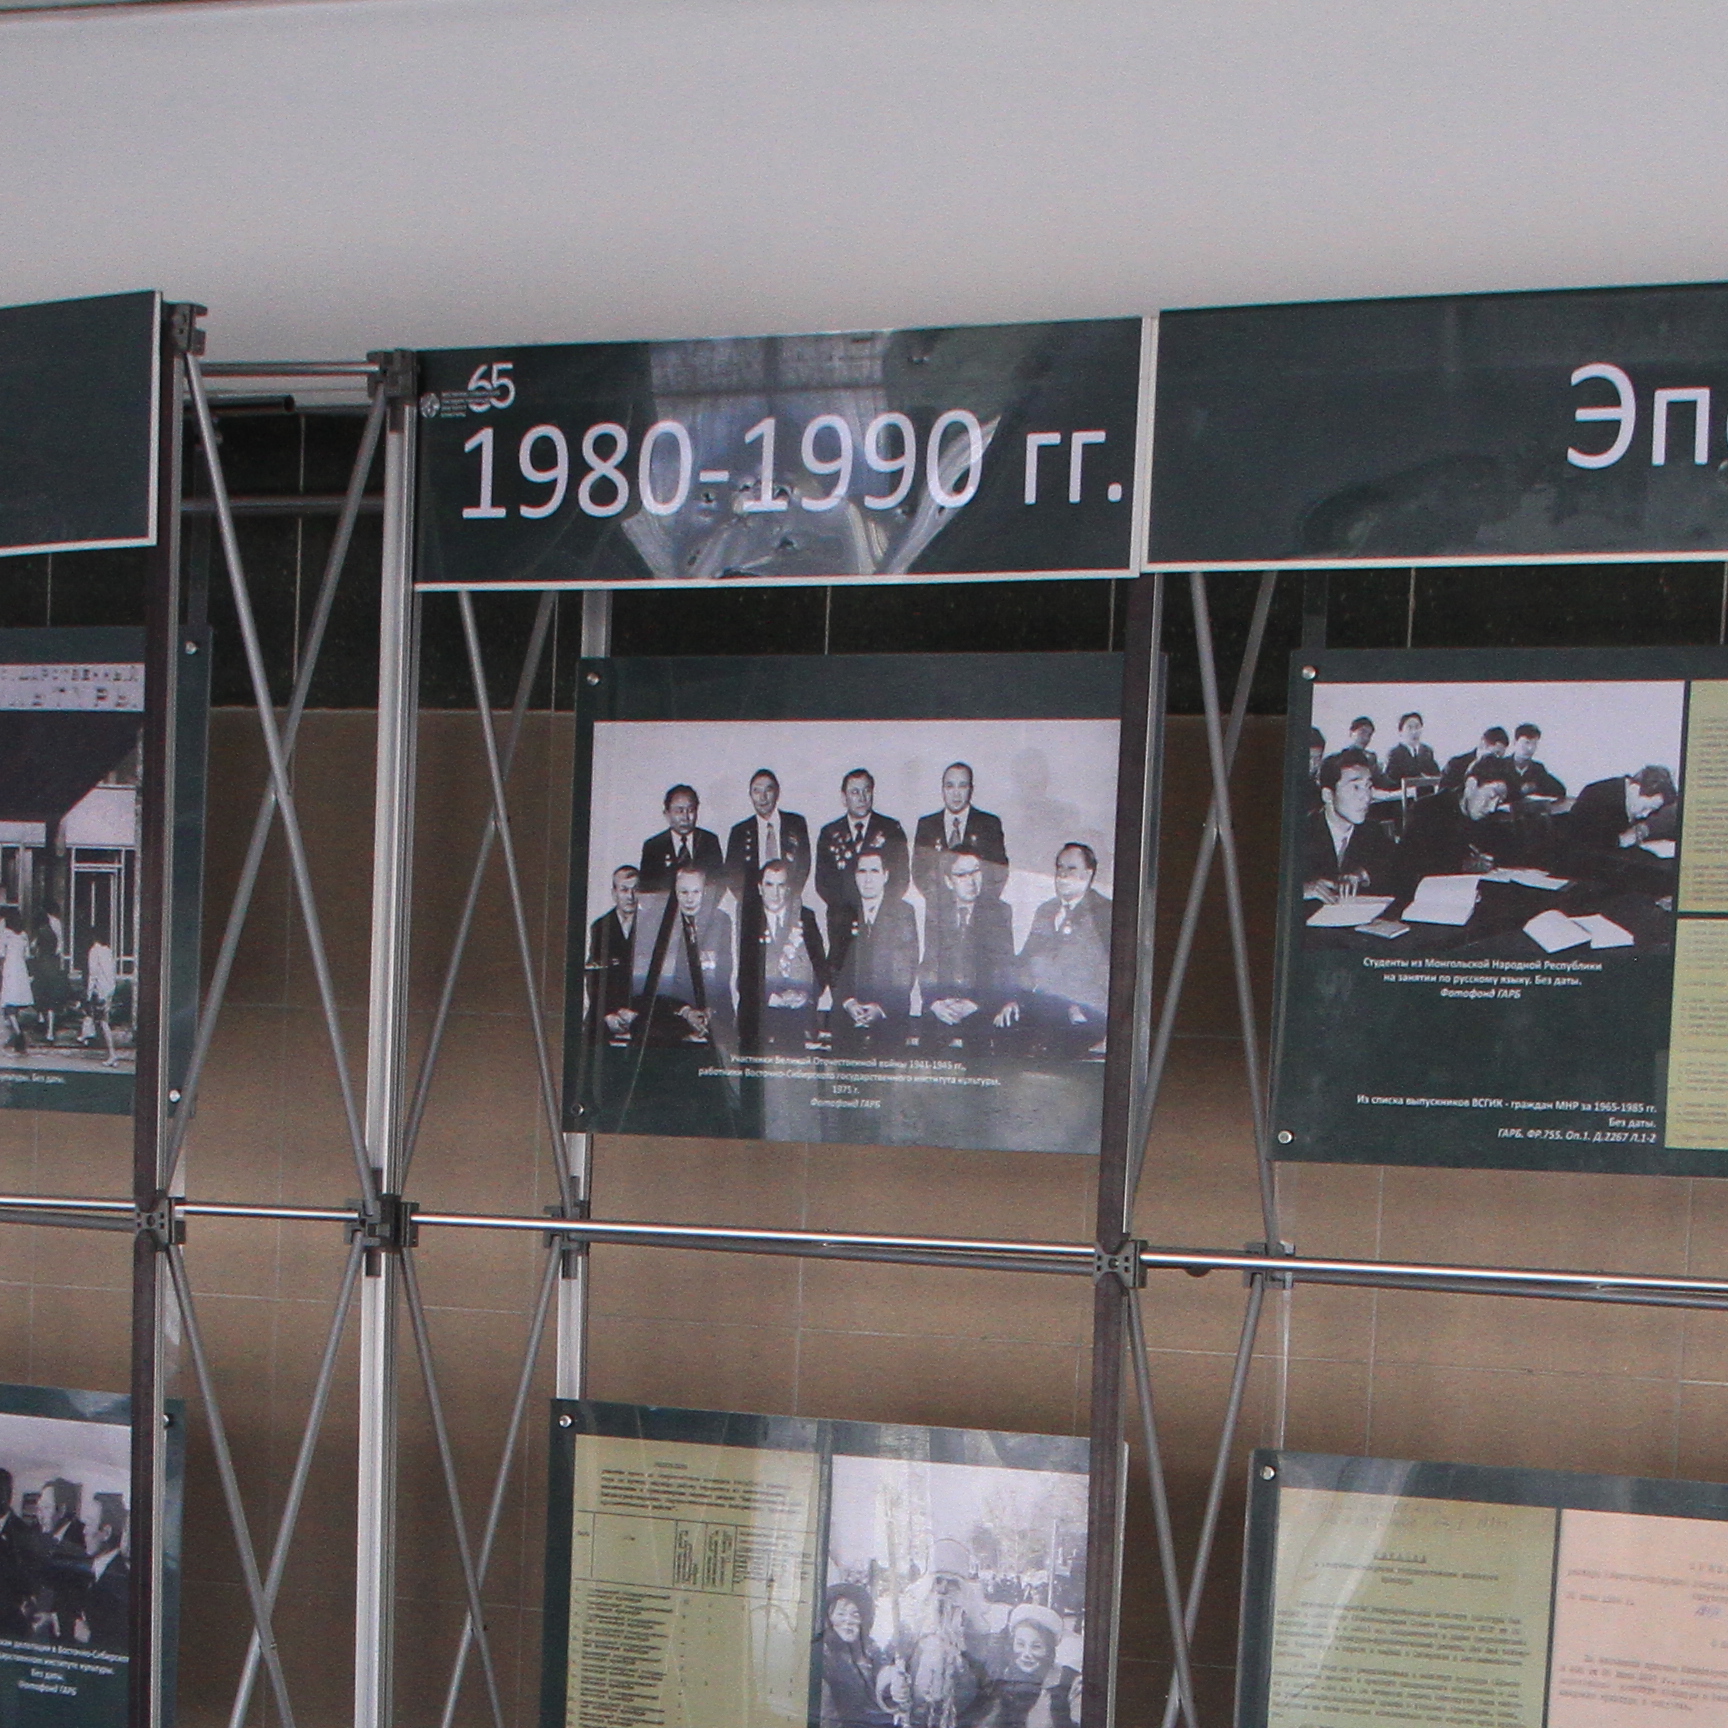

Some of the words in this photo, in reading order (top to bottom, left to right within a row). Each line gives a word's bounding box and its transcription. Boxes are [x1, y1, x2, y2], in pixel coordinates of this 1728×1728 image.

[468, 362, 515, 412] 65
[461, 409, 982, 520] 1980-1990
[1025, 430, 1122, 505] гг.
